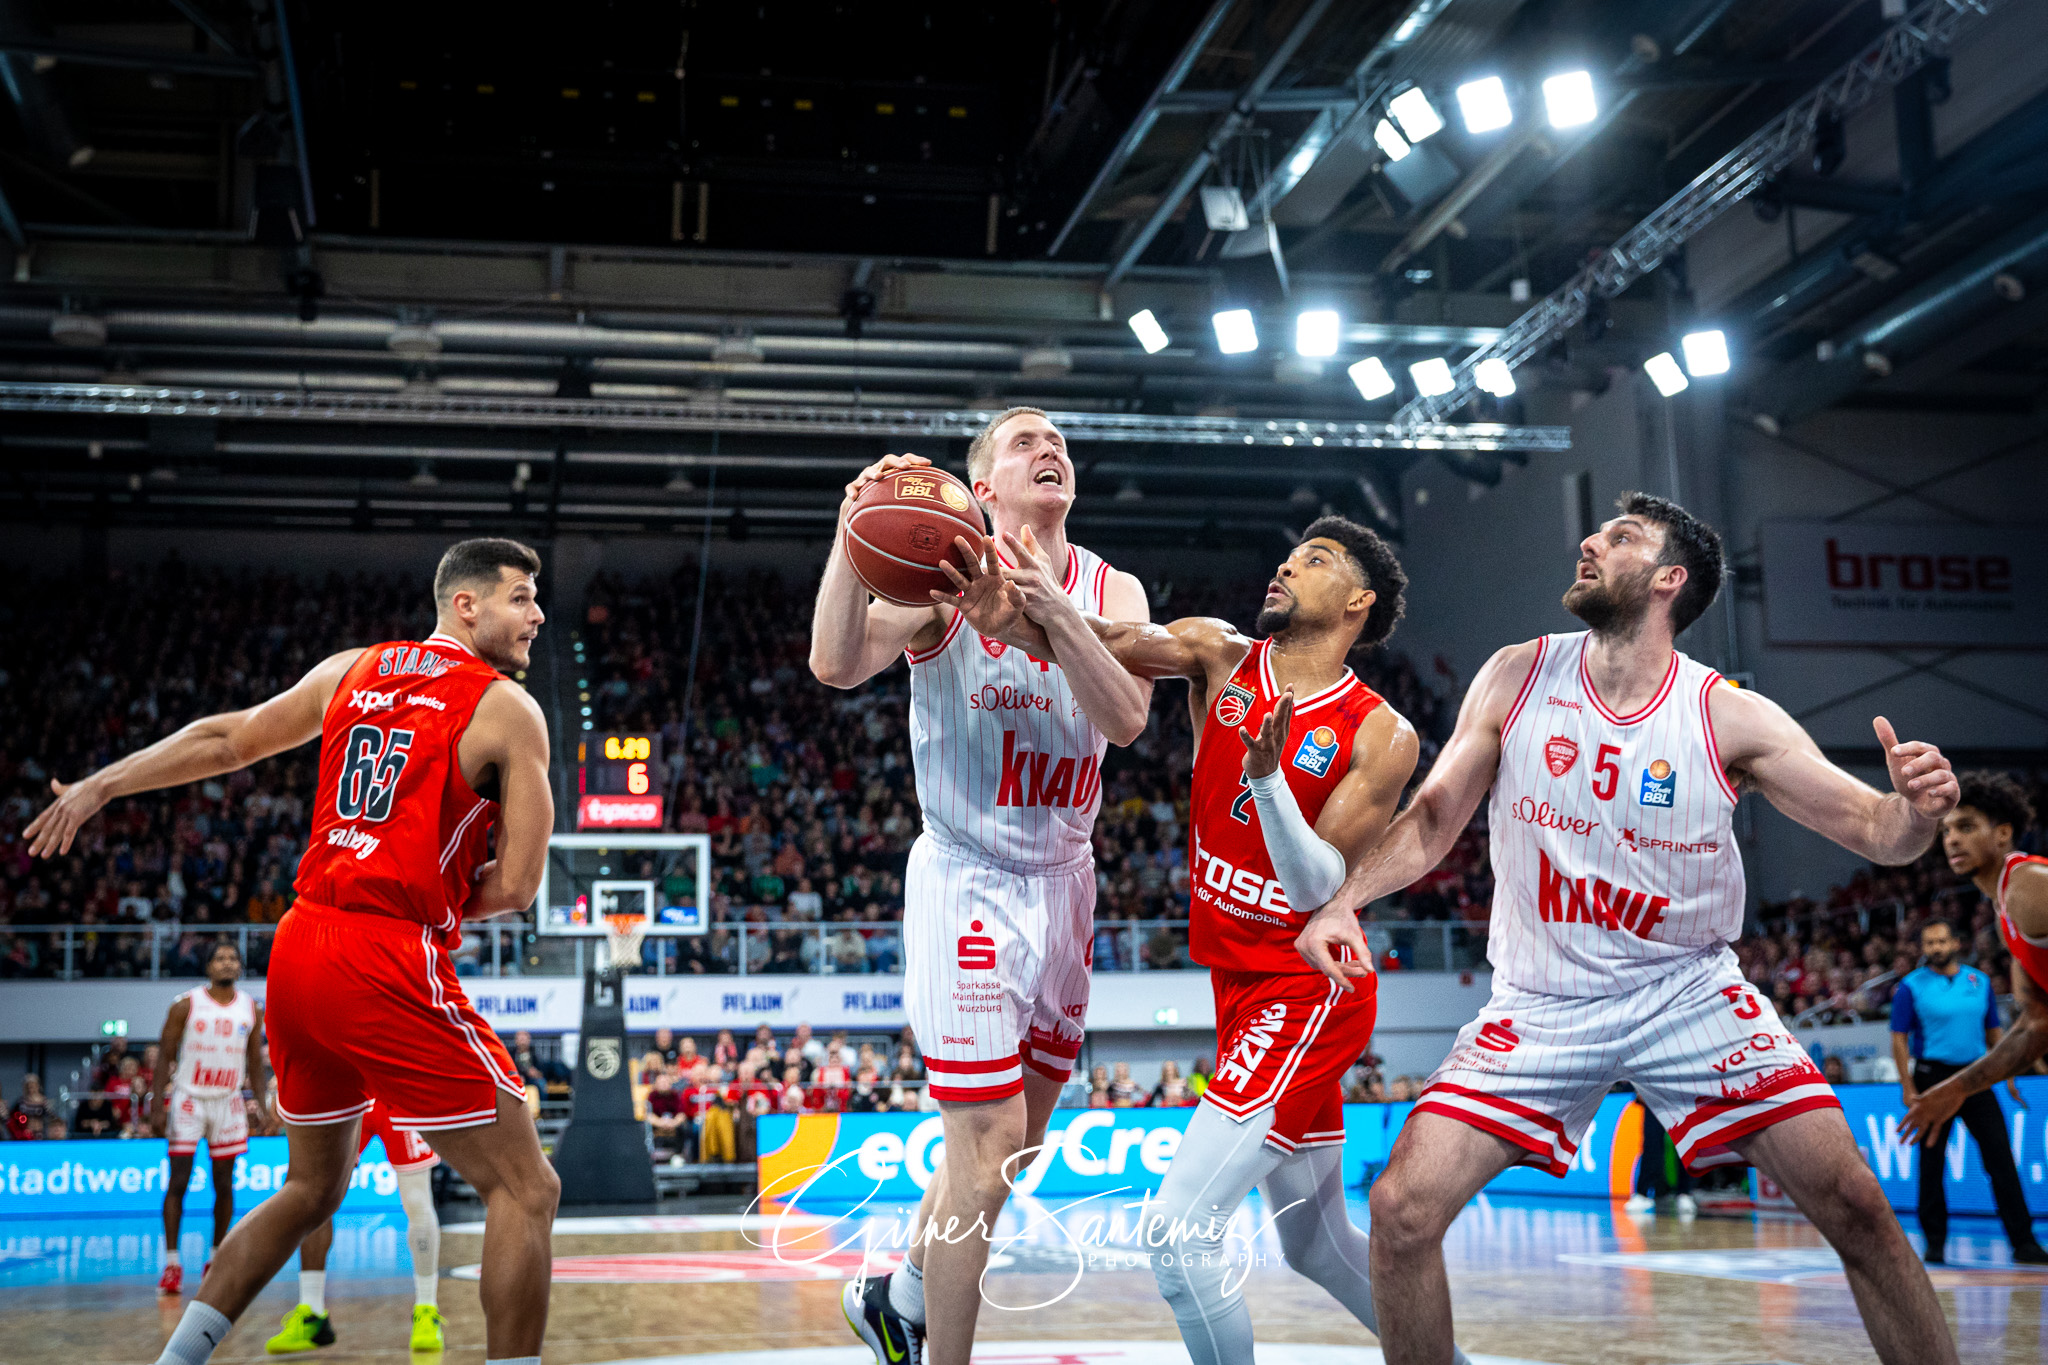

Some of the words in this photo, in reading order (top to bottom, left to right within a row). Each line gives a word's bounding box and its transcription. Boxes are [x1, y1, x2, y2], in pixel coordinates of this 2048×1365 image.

[900, 485, 935, 499] BBL
[1825, 538, 2013, 592] brose
[969, 684, 1053, 713] s.Oliver
[335, 724, 415, 822] 65
[996, 730, 1100, 816] KNAU
[1296, 753, 1323, 773] BBL
[1591, 742, 1622, 802] 5
[627, 762, 650, 795] 6
[587, 798, 657, 824] tipico
[1642, 791, 1671, 805] BBL
[1511, 796, 1600, 837] s.Oliver
[1638, 836, 1719, 854] SPRINTIS
[1538, 847, 1671, 940] KNAUF
[956, 980, 1001, 990] Sparkasse
[957, 1003, 1002, 1014] Würzburg
[942, 1035, 975, 1046] SPALDING
